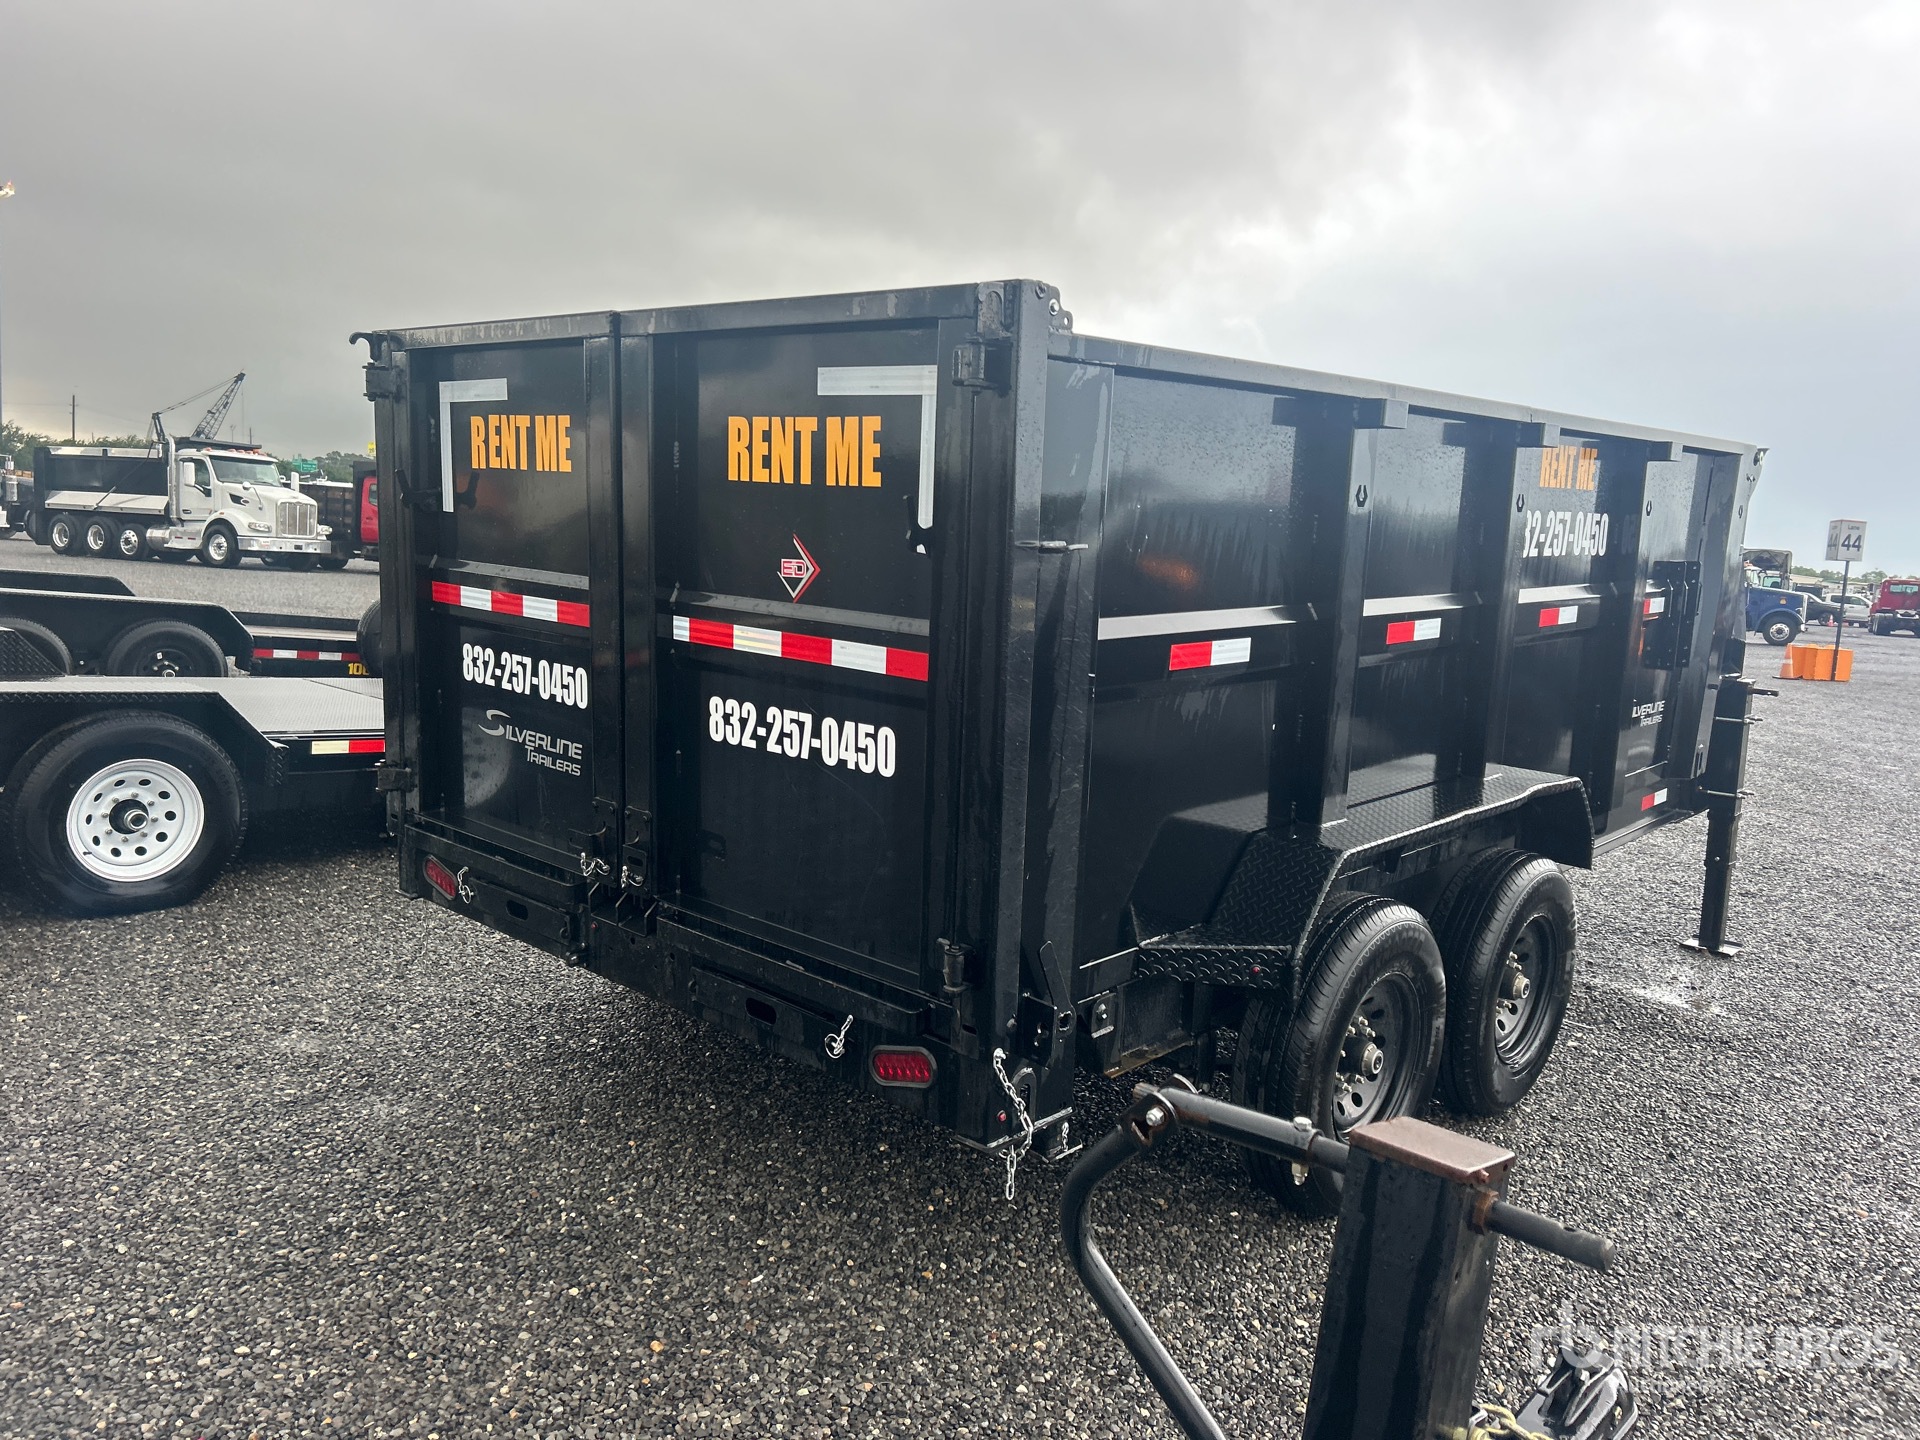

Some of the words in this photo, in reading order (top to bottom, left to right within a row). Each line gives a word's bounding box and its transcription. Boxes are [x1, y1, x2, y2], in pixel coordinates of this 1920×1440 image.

[470, 413, 530, 471] RENT
[534, 413, 573, 473] ME
[727, 415, 818, 486] RENT
[825, 415, 882, 488] ME
[1539, 444, 1577, 490] RENT
[1576, 446, 1599, 491] ME
[1841, 533, 1862, 552] 44
[462, 642, 589, 710] 832-257-0450
[477, 708, 583, 760] SILVERLINE
[1631, 699, 1666, 718] ILVERLINE
[524, 745, 582, 777] TRAILERS
[708, 695, 897, 778] 832-257-0450
